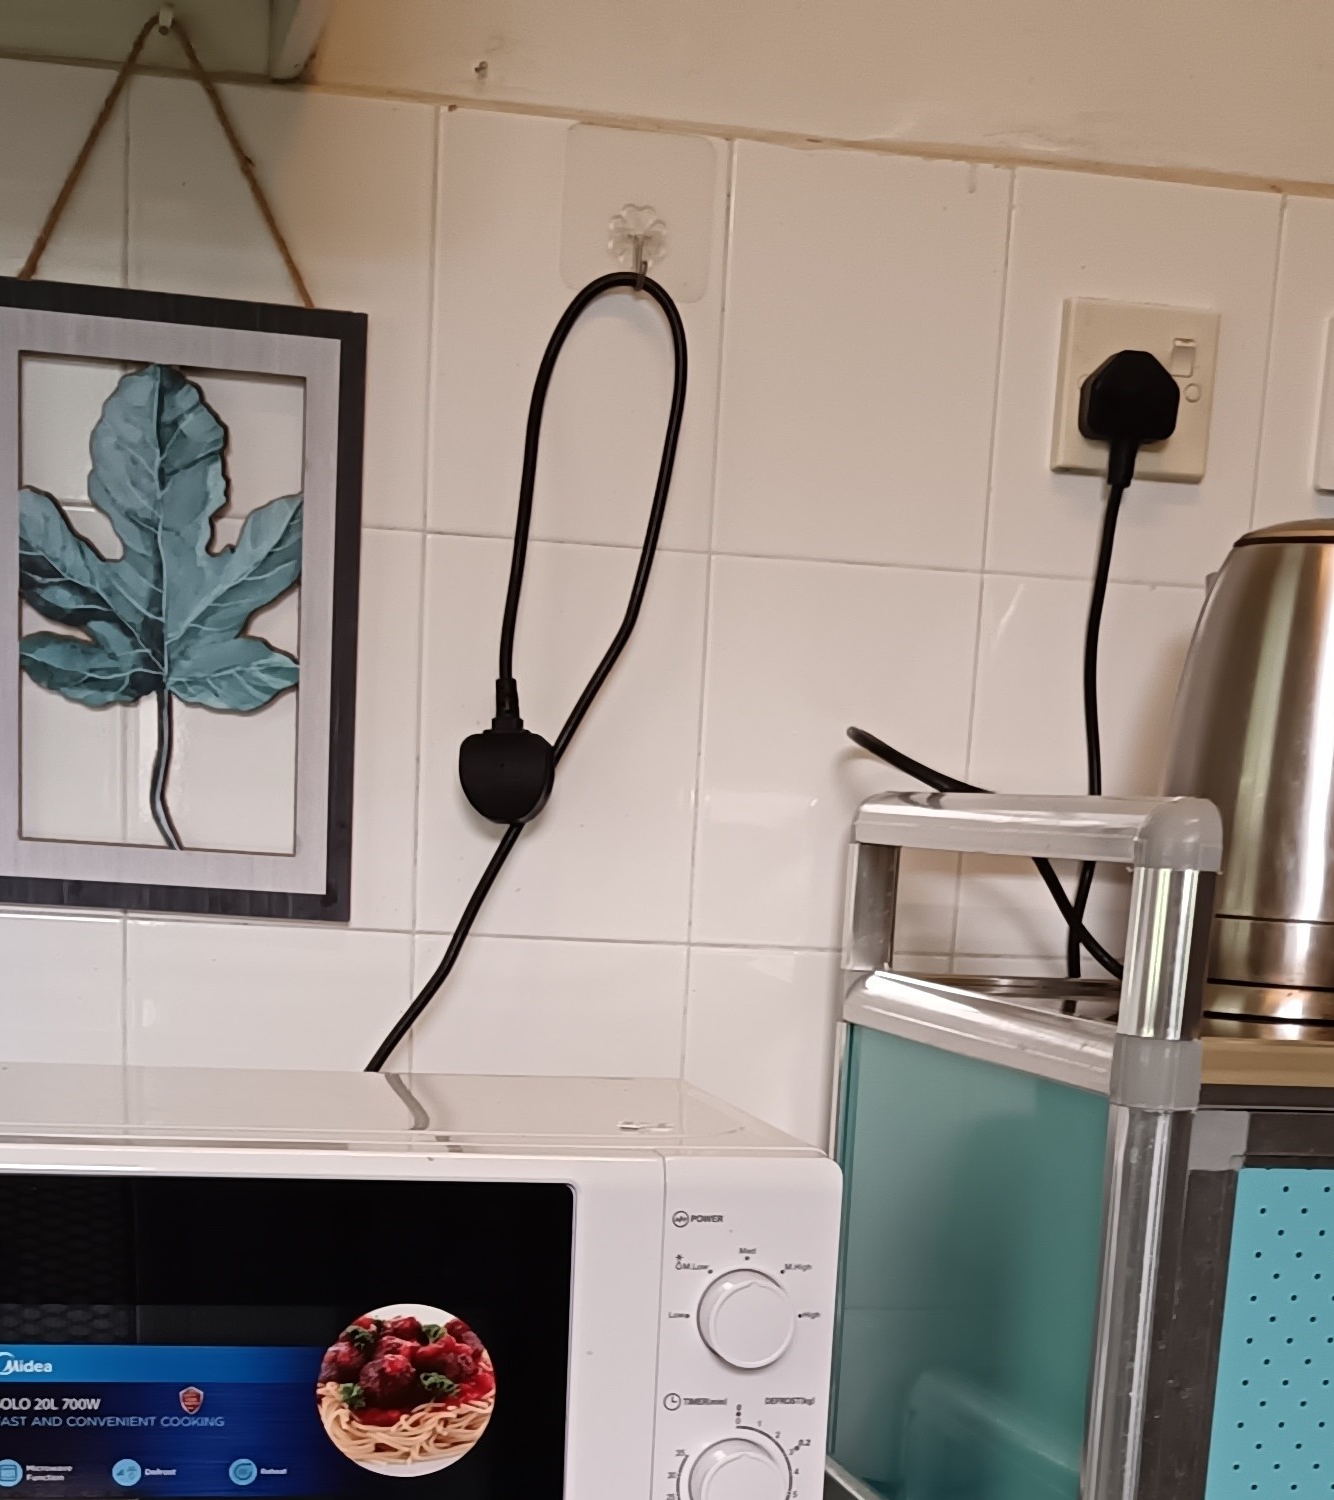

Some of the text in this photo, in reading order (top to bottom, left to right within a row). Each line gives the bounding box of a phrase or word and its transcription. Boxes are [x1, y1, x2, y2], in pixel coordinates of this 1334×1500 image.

[690, 1214, 724, 1223] POWER
[33, 1397, 59, 1411] 20L
[61, 1397, 101, 1411] 700W
[31, 1416, 63, 1427] AND
[66, 1416, 156, 1427] CONVENIENT
[160, 1416, 225, 1427] COOKING
